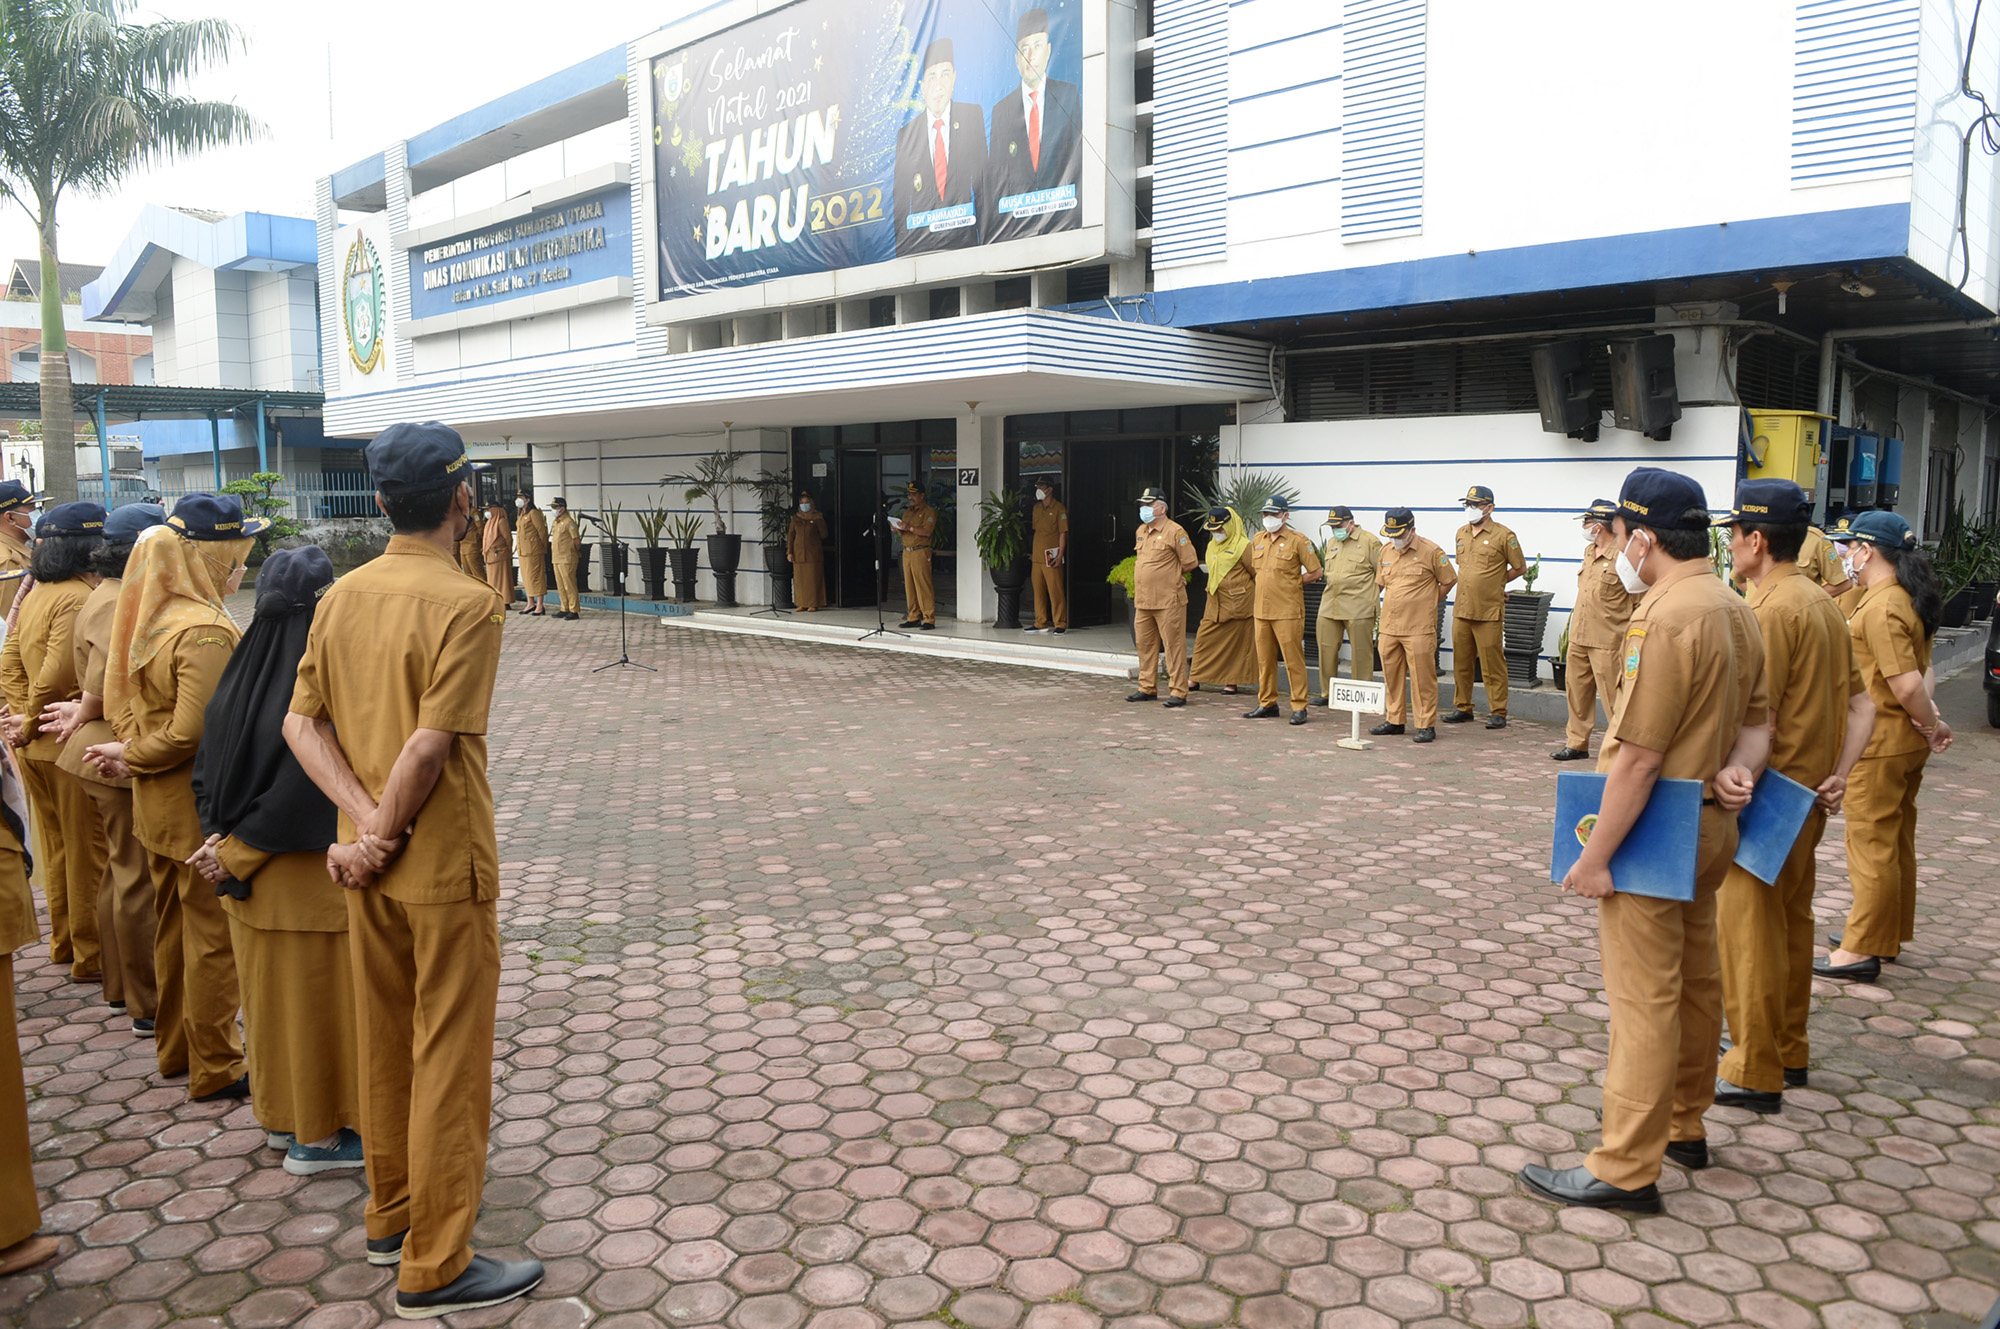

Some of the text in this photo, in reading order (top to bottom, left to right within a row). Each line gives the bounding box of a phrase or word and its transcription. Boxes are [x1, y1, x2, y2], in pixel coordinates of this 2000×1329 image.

[707, 26, 800, 92] Selamat
[707, 80, 812, 136] Natal 2021
[704, 104, 840, 196] TAHUN
[1001, 187, 1072, 209] MUSA RAJEKSHAH
[705, 183, 884, 261] BARU 2022
[912, 207, 967, 227] EDY RAHMAYADI
[424, 201, 604, 264] PEMERINTAH PROVINSI SUMATERA UTARA
[423, 226, 606, 291] DINAS KOMUNIKASI DAN INFORMATIKA
[492, 276, 509, 294] Said
[511, 275, 526, 289] No.
[527, 271, 538, 286] 27
[961, 470, 976, 484] 27
[1623, 499, 1649, 516] KORPRI
[1742, 504, 1769, 514] KORPRI
[215, 522, 240, 530] KORPRI
[654, 603, 687, 614] KADIS
[1336, 688, 1366, 703] ESELON
[1371, 692, 1379, 704] IV
